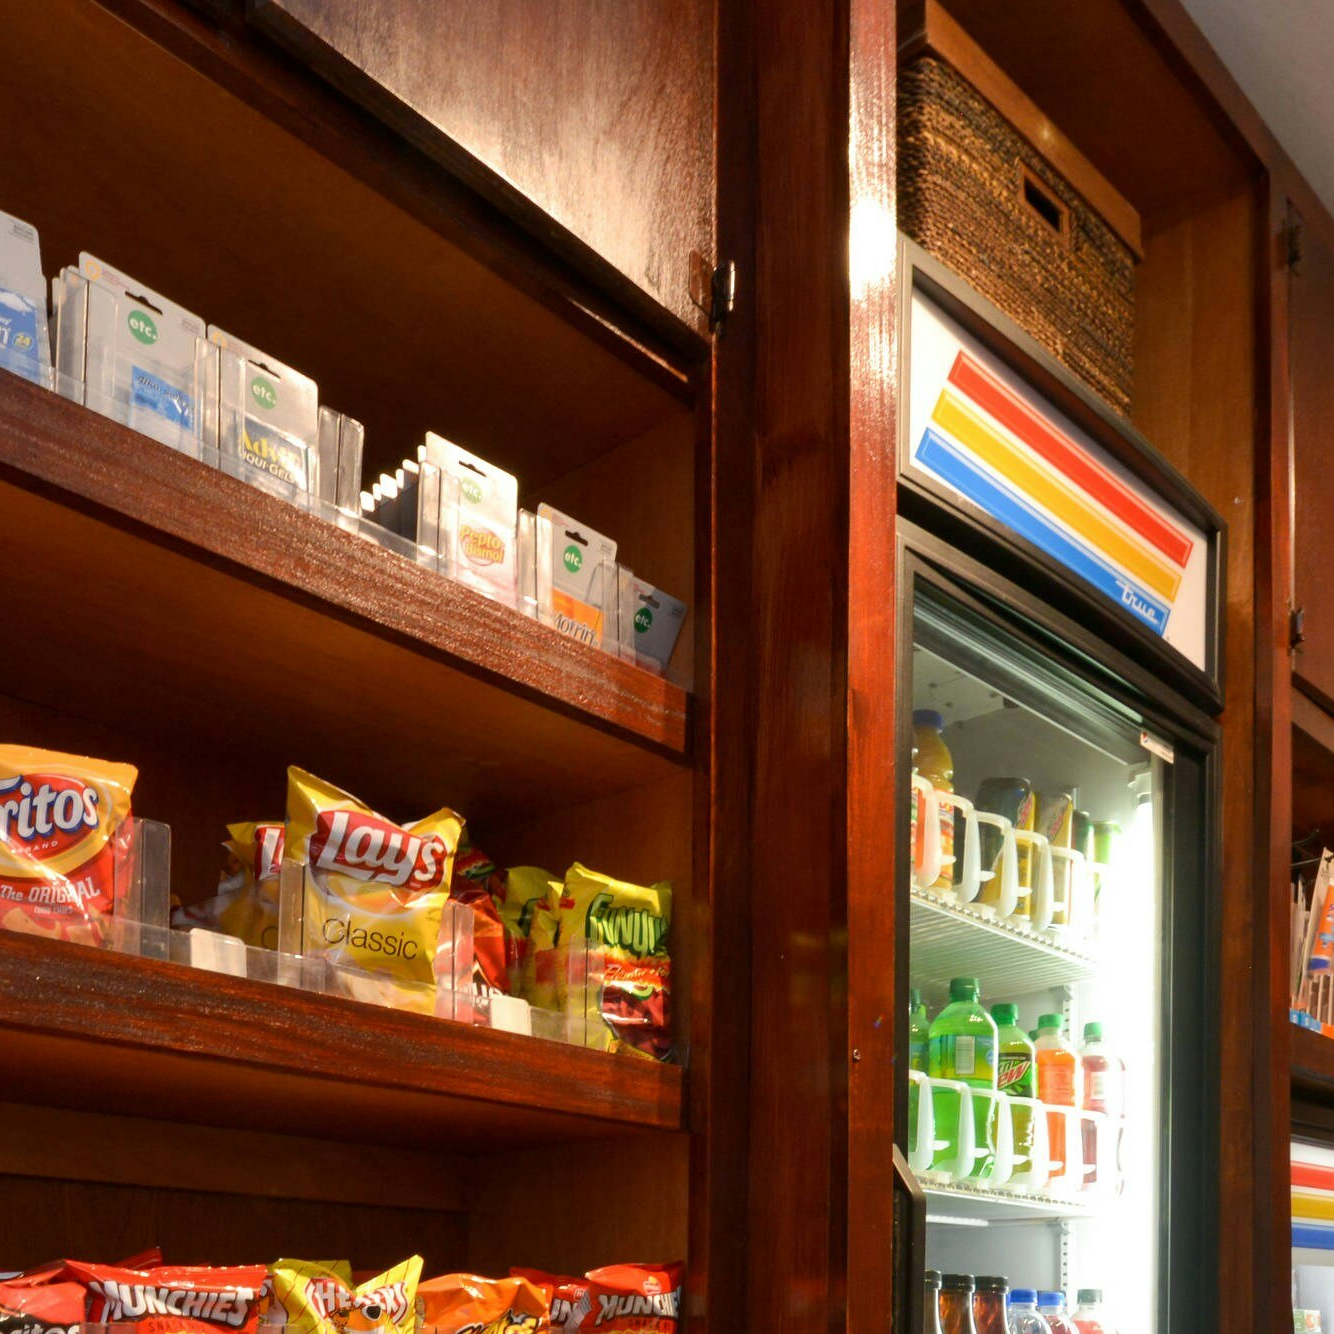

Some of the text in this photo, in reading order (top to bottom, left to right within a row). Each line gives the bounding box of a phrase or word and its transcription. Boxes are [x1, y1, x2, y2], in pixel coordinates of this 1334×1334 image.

[129, 318, 157, 340] etc.
[252, 383, 276, 405] etc.
[460, 525, 501, 549] Pepto
[465, 542, 504, 562] Bismol
[565, 551, 582, 568] etc.
[0, 884, 23, 901] The
[322, 918, 419, 960] Classic
[89, 1280, 255, 1327] MUNCHIES
